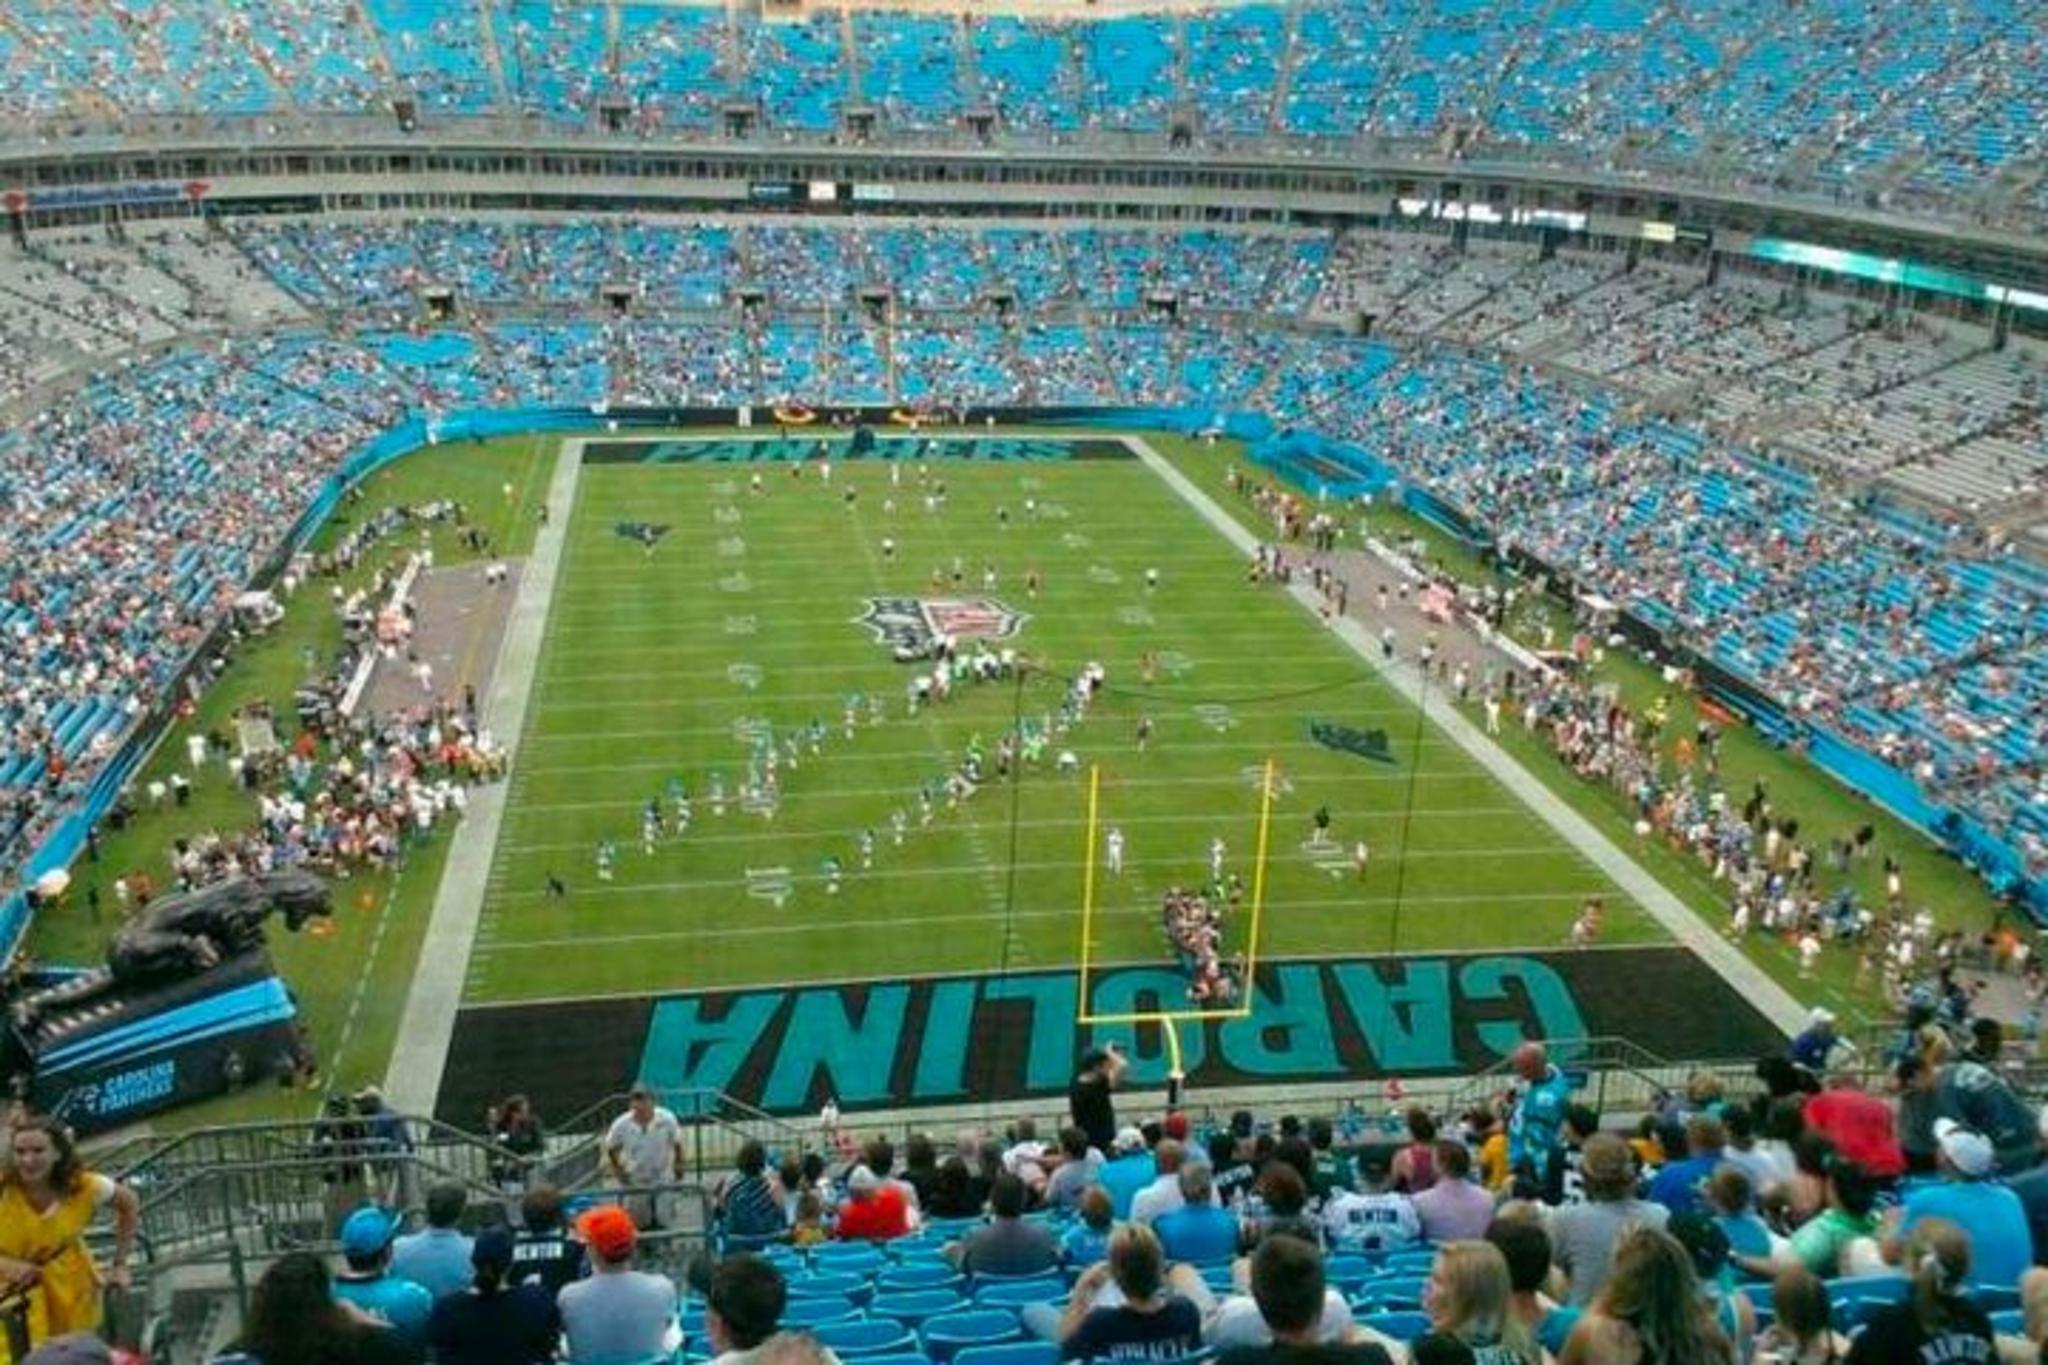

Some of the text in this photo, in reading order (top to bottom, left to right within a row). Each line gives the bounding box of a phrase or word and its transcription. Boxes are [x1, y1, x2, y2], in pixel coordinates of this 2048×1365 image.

[636, 956, 1589, 1120] CAROLINA
[104, 1059, 175, 1097] CAROLINA
[100, 1080, 174, 1114] PANTHERS
[1347, 1208, 1398, 1223] NEWTON
